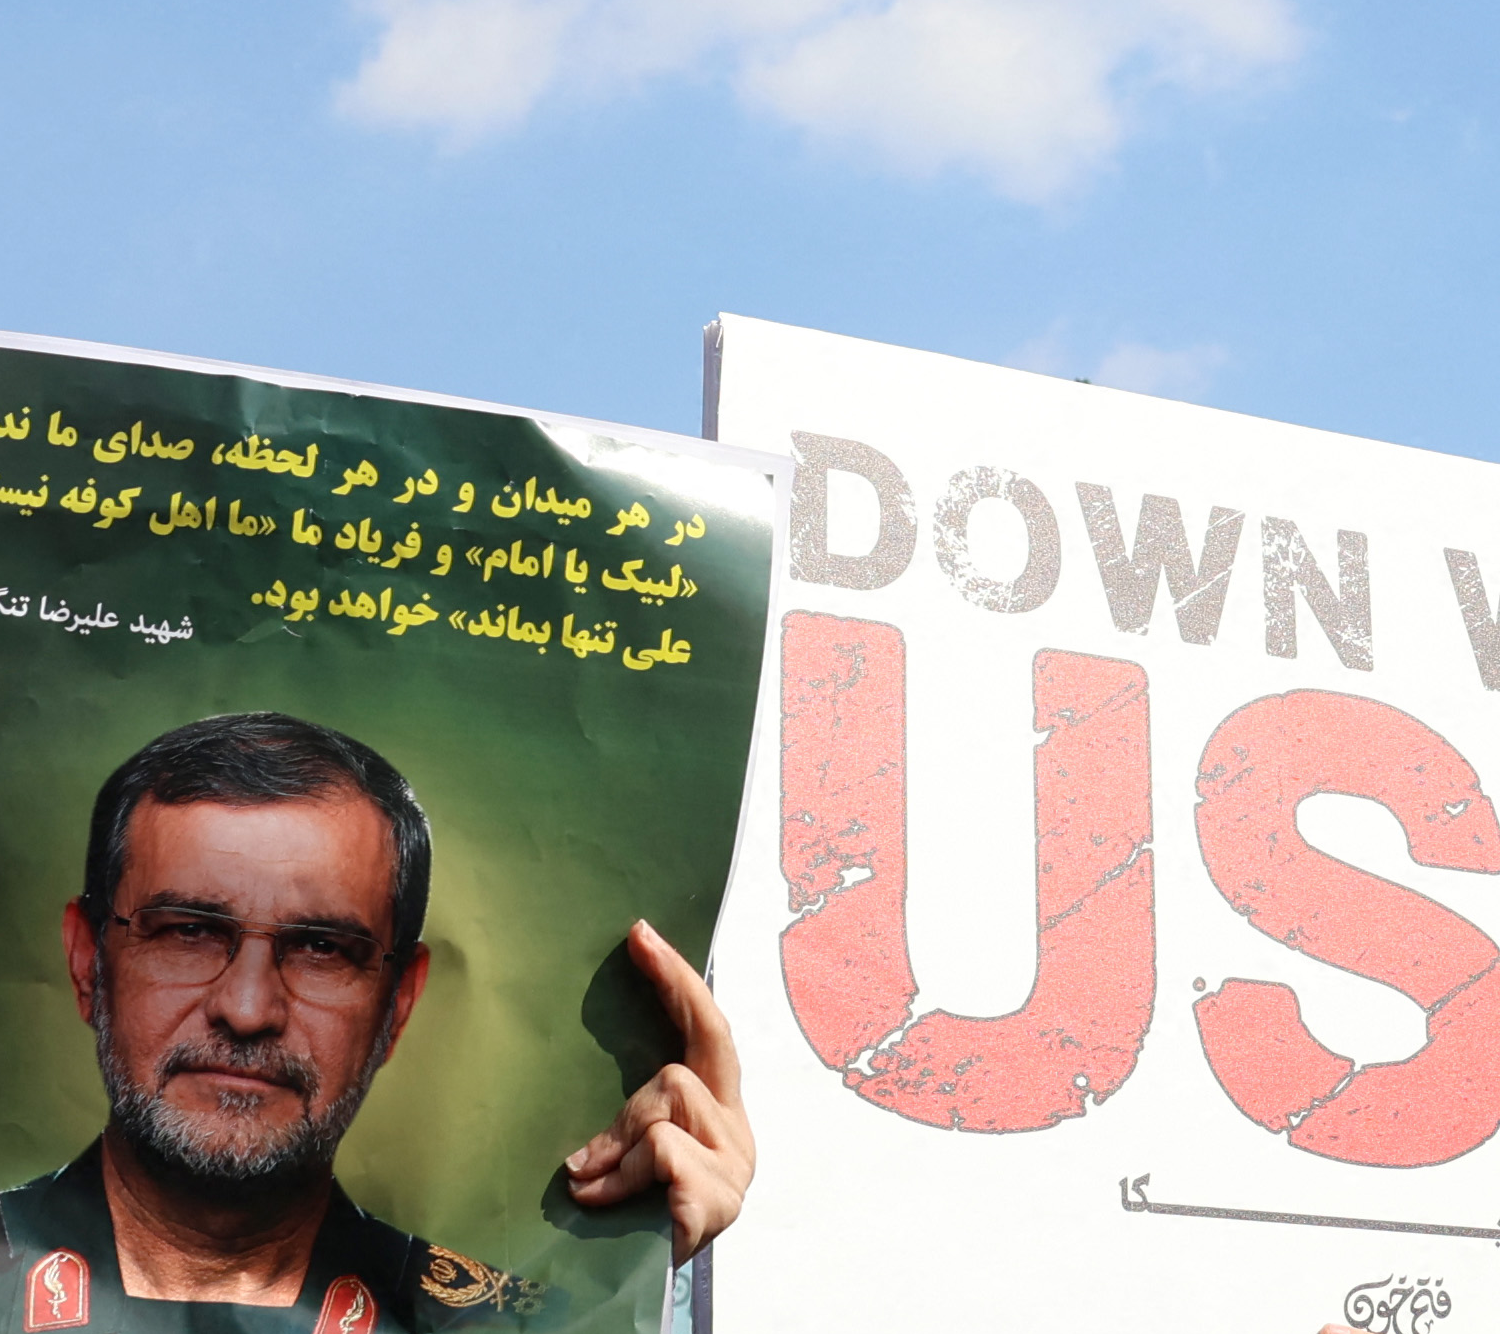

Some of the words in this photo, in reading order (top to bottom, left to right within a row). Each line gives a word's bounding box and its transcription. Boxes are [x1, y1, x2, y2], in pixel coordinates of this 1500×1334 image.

[48, 412, 77, 446] ما
[93, 422, 194, 463] صدای
[332, 460, 378, 495] هر
[394, 469, 438, 503] در
[453, 482, 474, 512] و
[60, 479, 141, 528] کوفه
[150, 493, 216, 535] اهل
[491, 477, 591, 525] میدان
[607, 503, 650, 535] هر
[292, 509, 322, 545] ما
[335, 518, 421, 568] فریاد
[666, 516, 706, 545] در
[431, 545, 452, 575] و
[565, 549, 588, 593] یا
[788, 429, 1376, 673] DOWN
[40, 596, 118, 634] علیرضا
[252, 581, 318, 621] بود.
[329, 588, 439, 635] خواهد
[130, 615, 192, 644] شهید
[562, 614, 617, 658] تنها
[623, 629, 690, 670] علی
